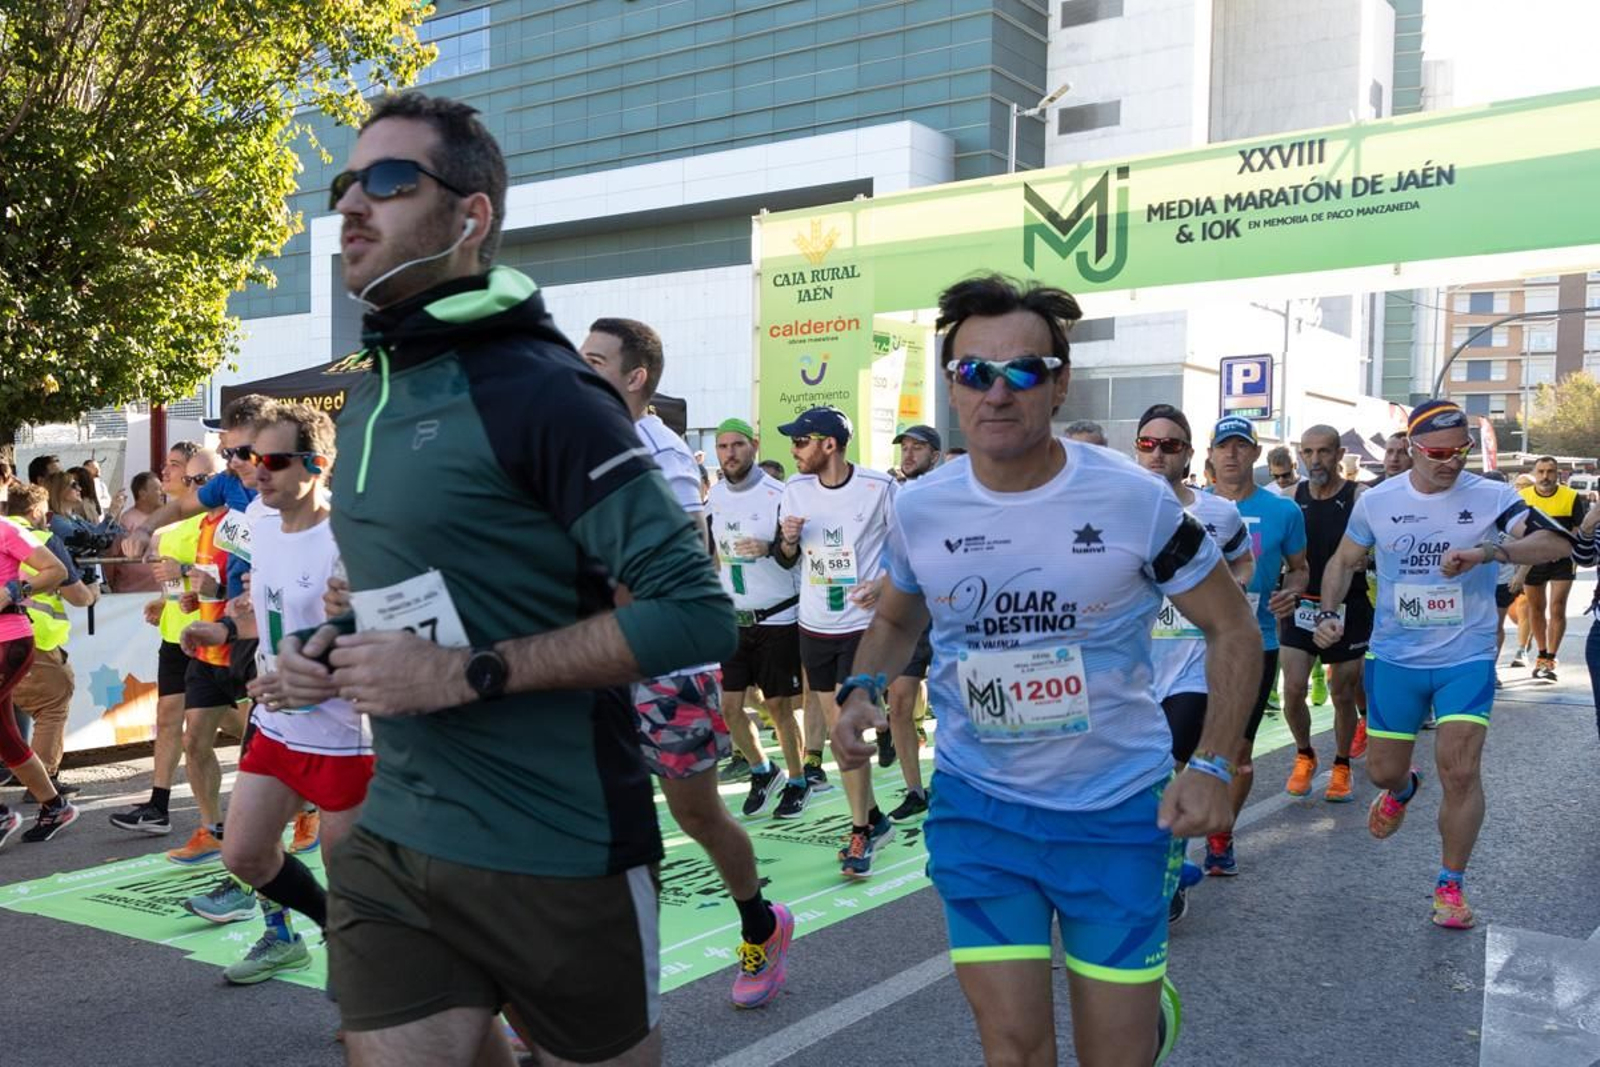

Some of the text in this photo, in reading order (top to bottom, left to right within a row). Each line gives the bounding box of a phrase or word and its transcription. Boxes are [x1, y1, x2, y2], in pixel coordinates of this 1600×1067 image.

[1237, 138, 1327, 175] XXVIII
[1146, 160, 1455, 223] MEDIA MARATÓN DE JAÉN
[1248, 201, 1420, 229] EN MEMORIA DE PACO MANZANEDA
[1175, 223, 1195, 244] &
[773, 264, 860, 287] CAJA RURAL
[797, 285, 834, 304] JAÉN
[769, 315, 860, 338] calderón
[1231, 362, 1261, 394] P
[779, 390, 850, 404] Ayuntamiento
[828, 558, 851, 570] 583
[1410, 554, 1442, 567] DESTI
[949, 567, 1077, 620] VOLAR es
[1427, 598, 1455, 611] 801
[965, 613, 1076, 636] mi DESTINO
[1009, 675, 1082, 702] 1200
